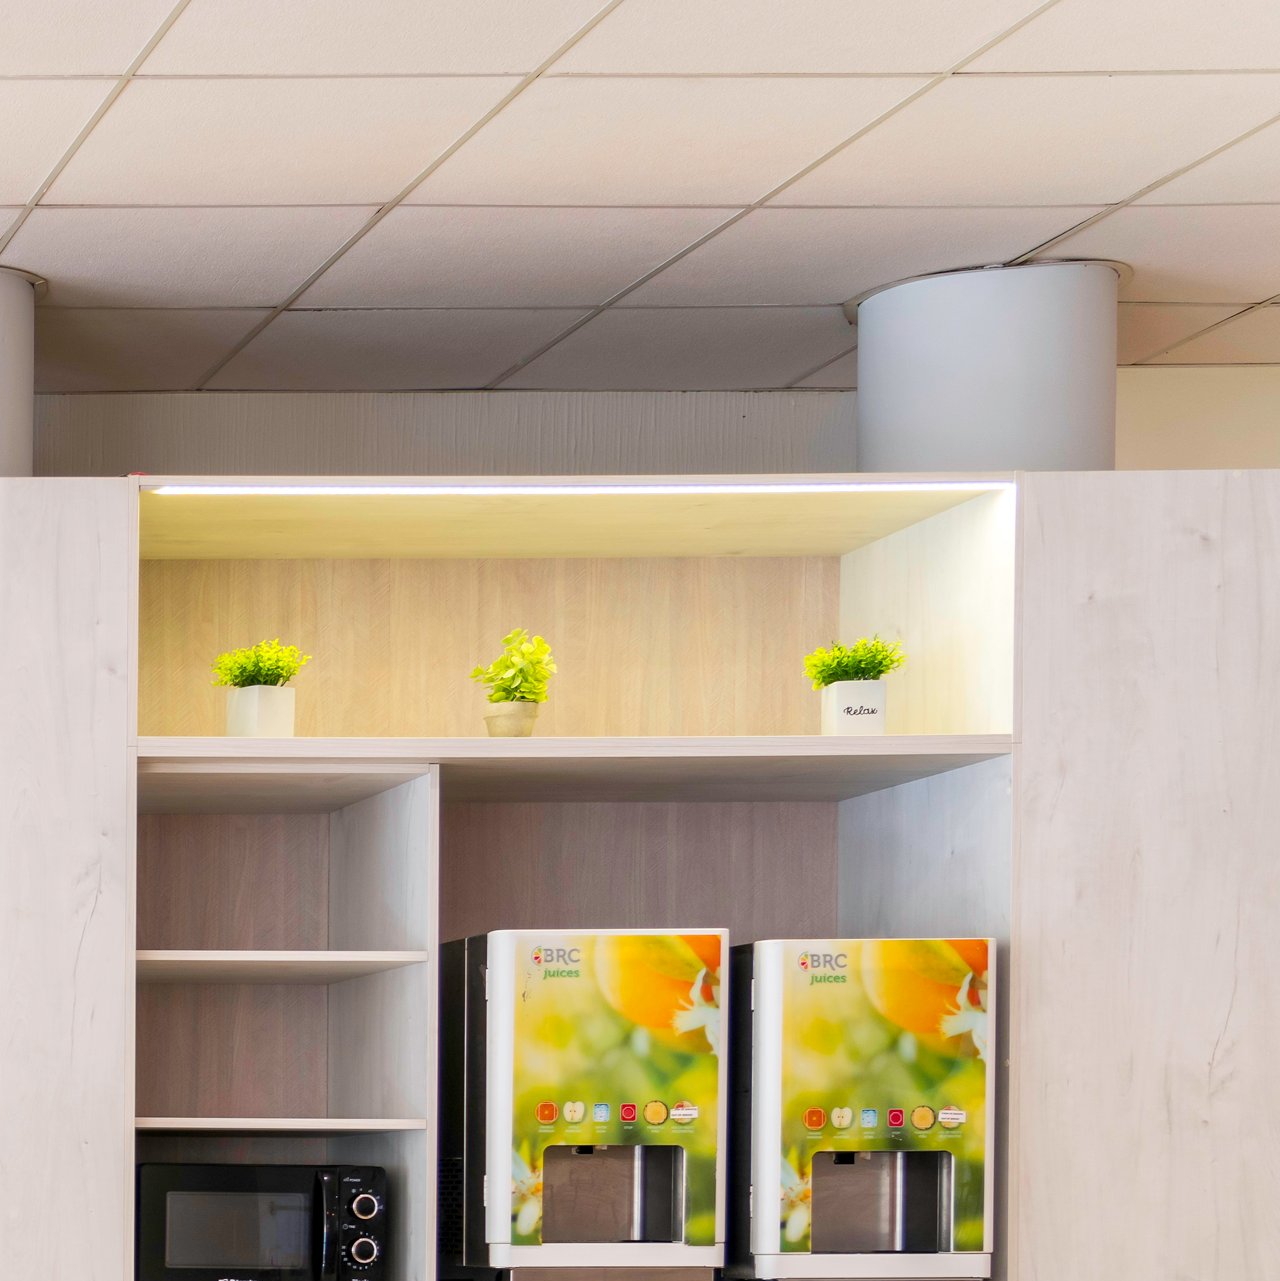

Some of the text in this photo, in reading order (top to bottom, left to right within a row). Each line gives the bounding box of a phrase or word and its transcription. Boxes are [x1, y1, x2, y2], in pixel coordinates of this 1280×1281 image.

[843, 705, 878, 716] Relax
[543, 948, 581, 966] BRC
[810, 953, 848, 971] BRC
[543, 968, 580, 980] juices
[809, 974, 848, 986] juices
